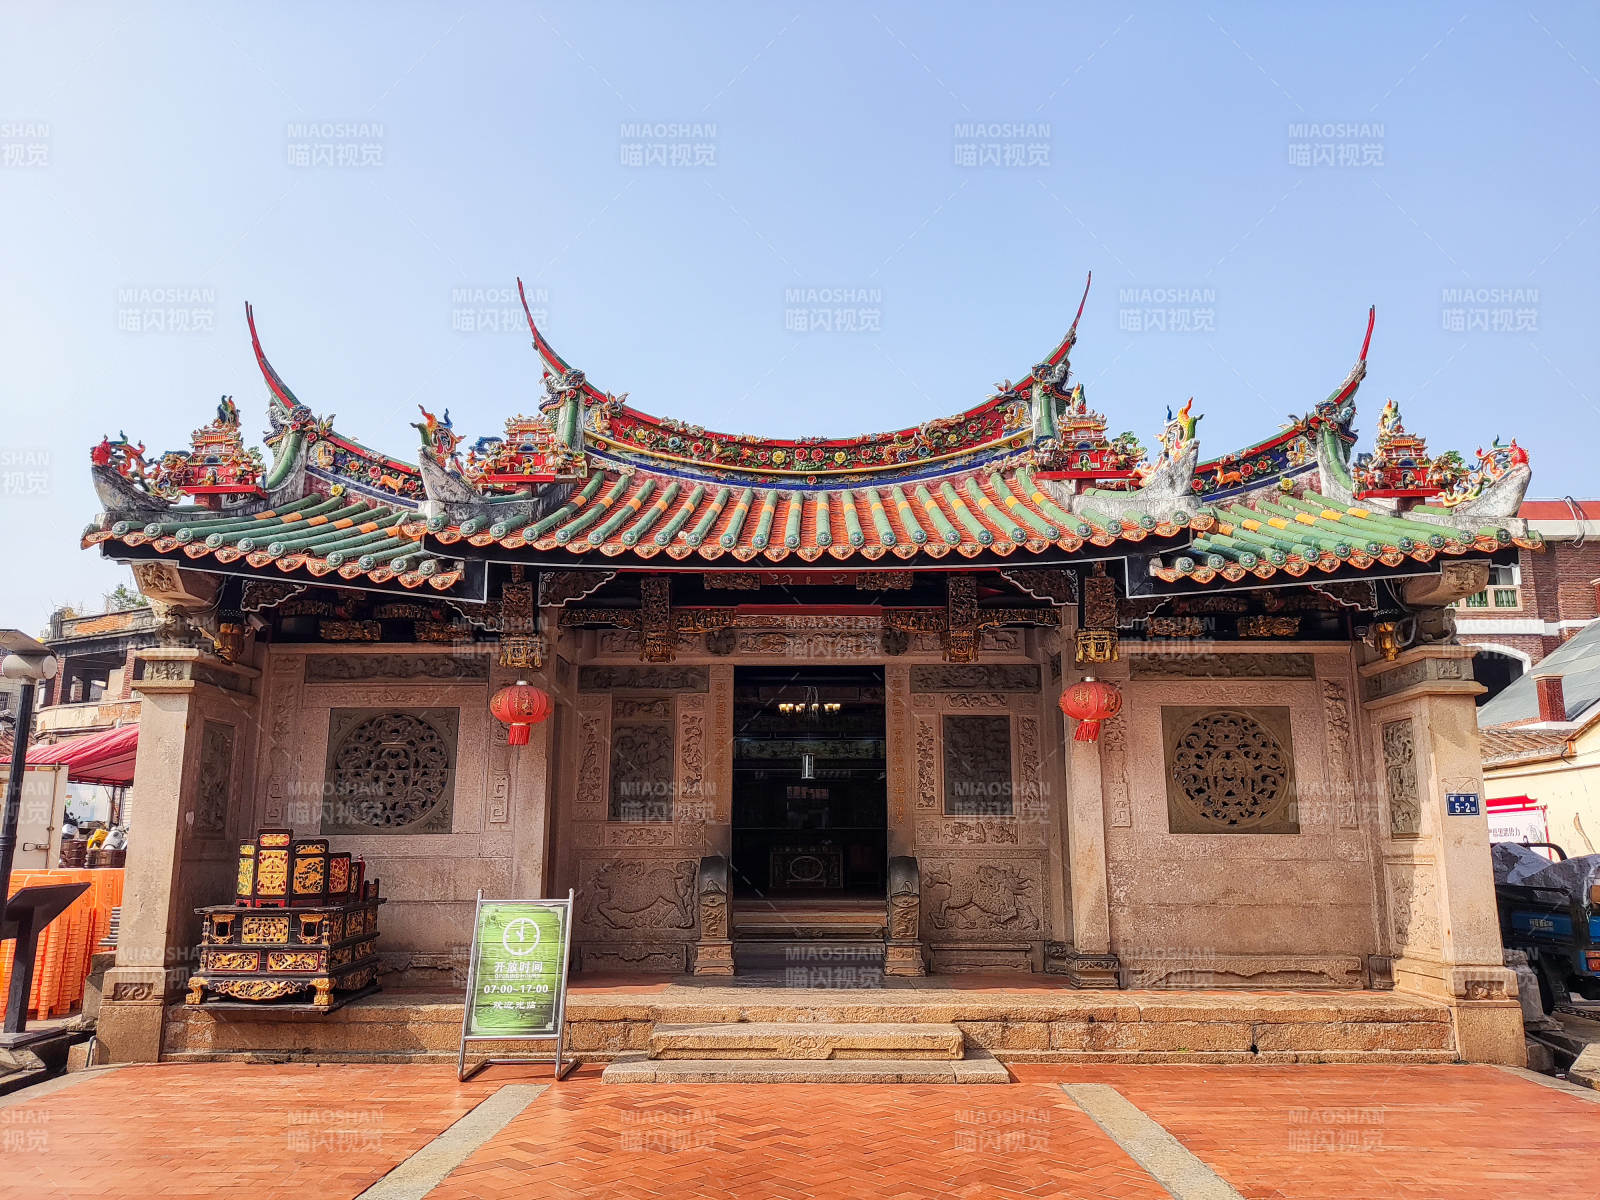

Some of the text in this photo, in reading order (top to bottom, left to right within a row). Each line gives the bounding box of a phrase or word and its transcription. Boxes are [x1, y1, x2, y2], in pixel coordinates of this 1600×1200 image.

[494, 961, 543, 973] 开放时间
[483, 984, 549, 994] 07:00~17:00
[493, 1001, 537, 1009] 欢迎光临
